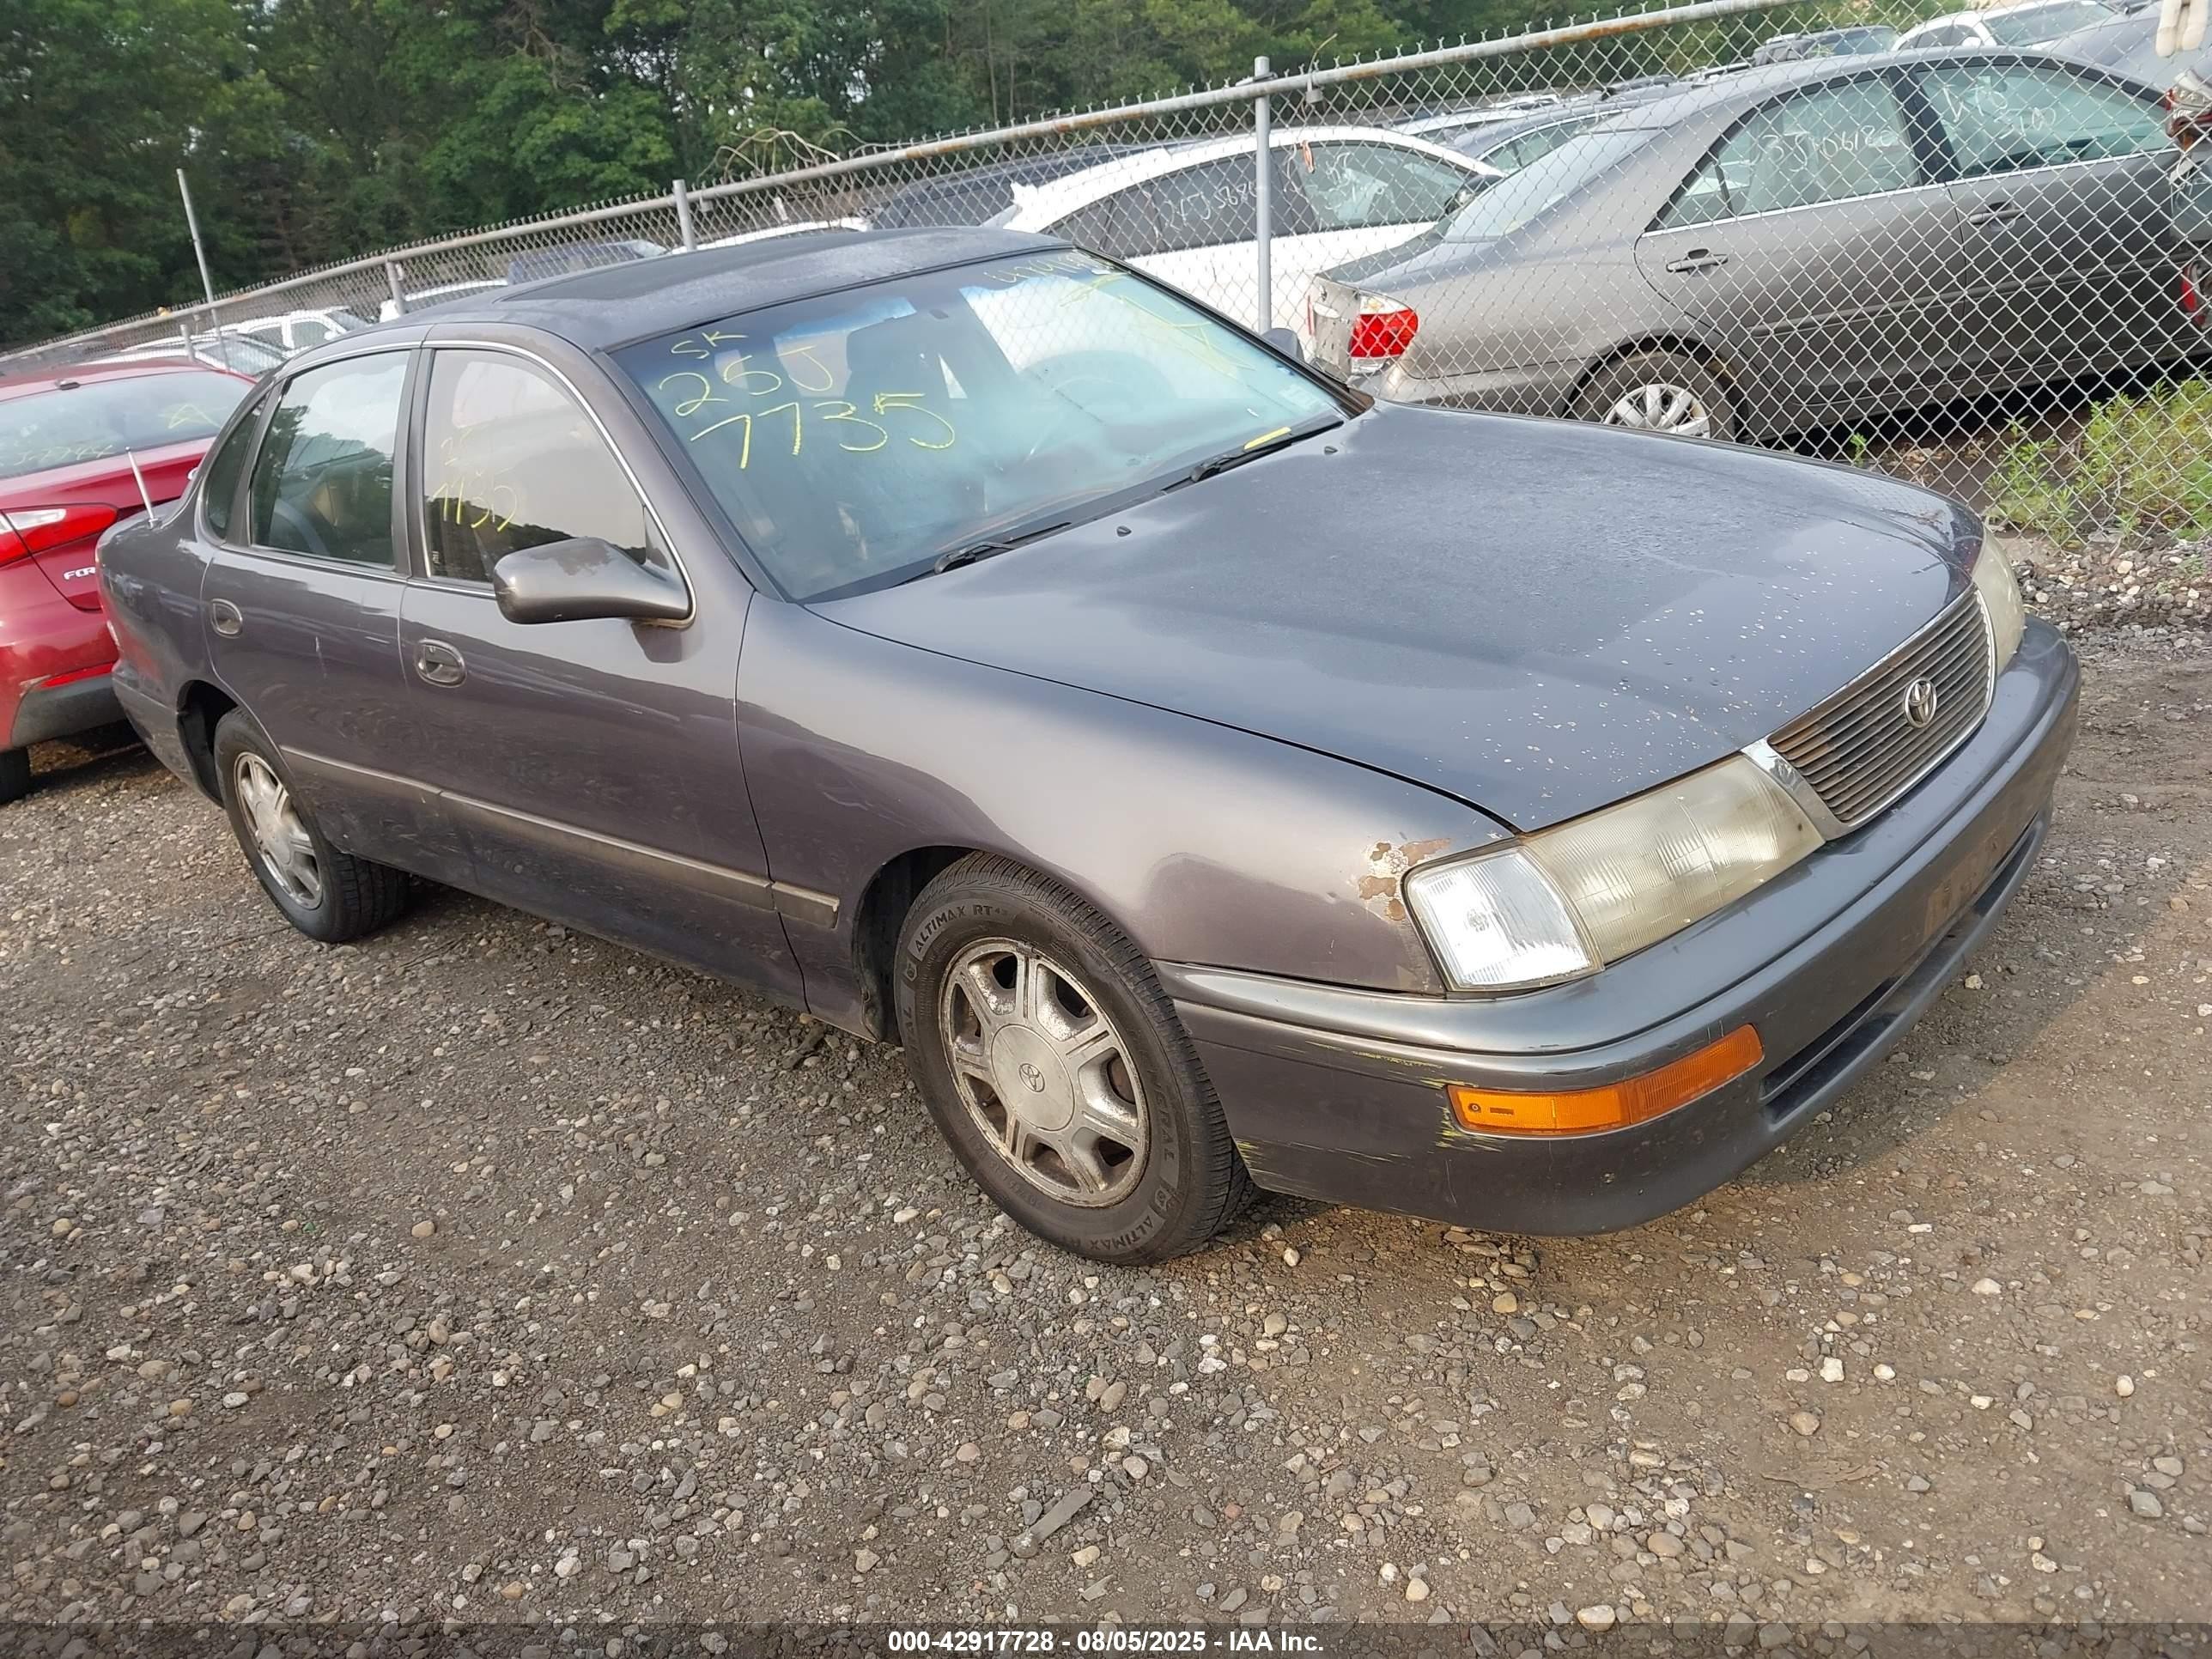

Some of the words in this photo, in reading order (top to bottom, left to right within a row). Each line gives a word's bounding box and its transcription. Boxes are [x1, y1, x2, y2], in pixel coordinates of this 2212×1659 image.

[690, 392, 955, 469] 7735
[63, 566, 96, 580] FOR
[915, 905, 965, 953] ALTIMAX
[1090, 1215, 1154, 1250] ALTIMAX
